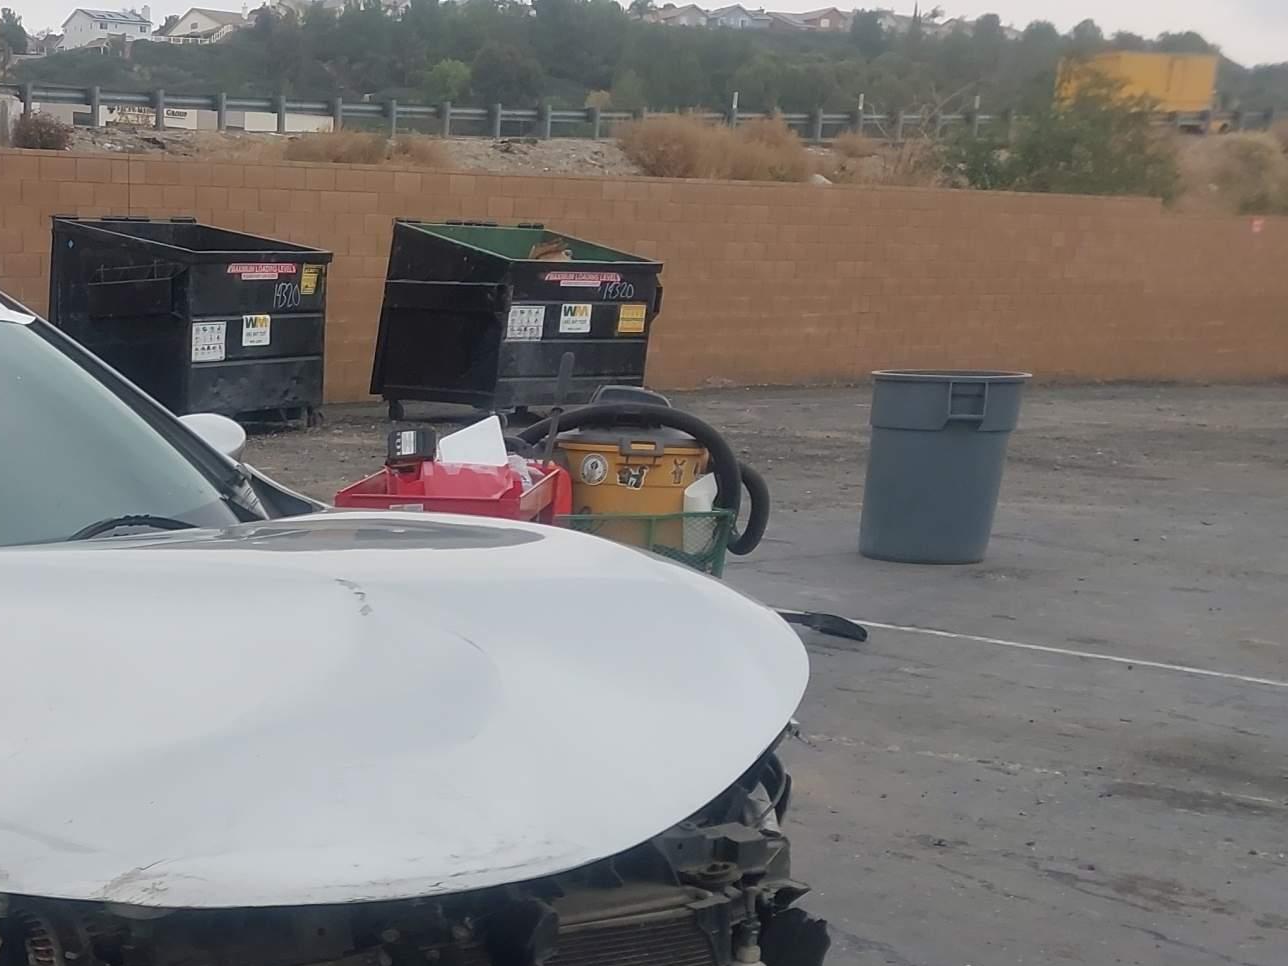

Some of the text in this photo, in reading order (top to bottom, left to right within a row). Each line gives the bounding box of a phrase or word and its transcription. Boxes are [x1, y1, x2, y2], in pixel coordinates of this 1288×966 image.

[255, 263, 277, 273] LOADING
[563, 305, 589, 316] WM
[245, 316, 268, 328] WM
